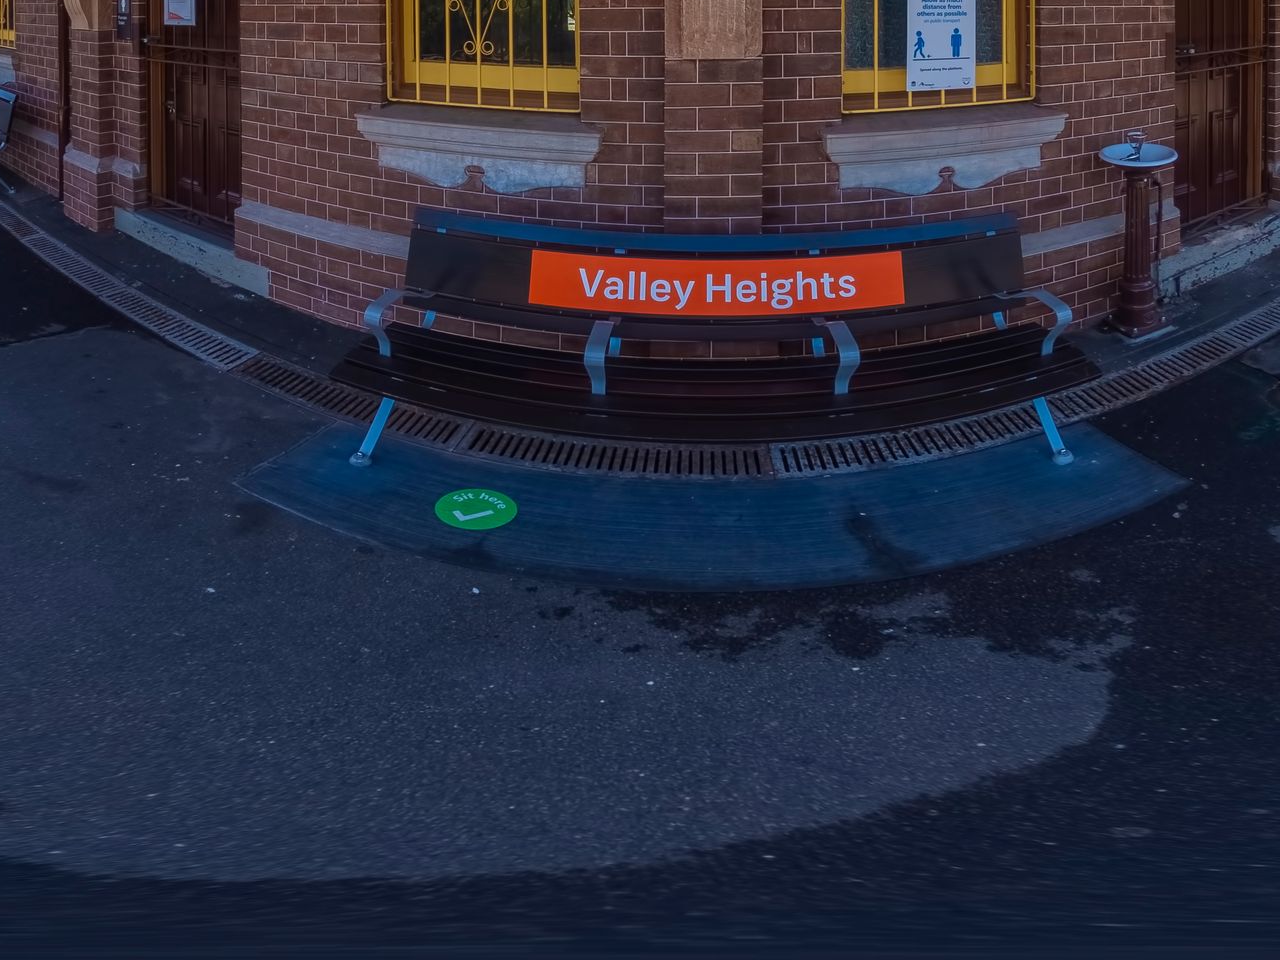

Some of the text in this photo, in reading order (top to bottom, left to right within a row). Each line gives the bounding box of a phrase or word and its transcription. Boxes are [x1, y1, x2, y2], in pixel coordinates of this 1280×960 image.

[579, 268, 857, 311] Valley Heights
[453, 492, 507, 510] Sit here
